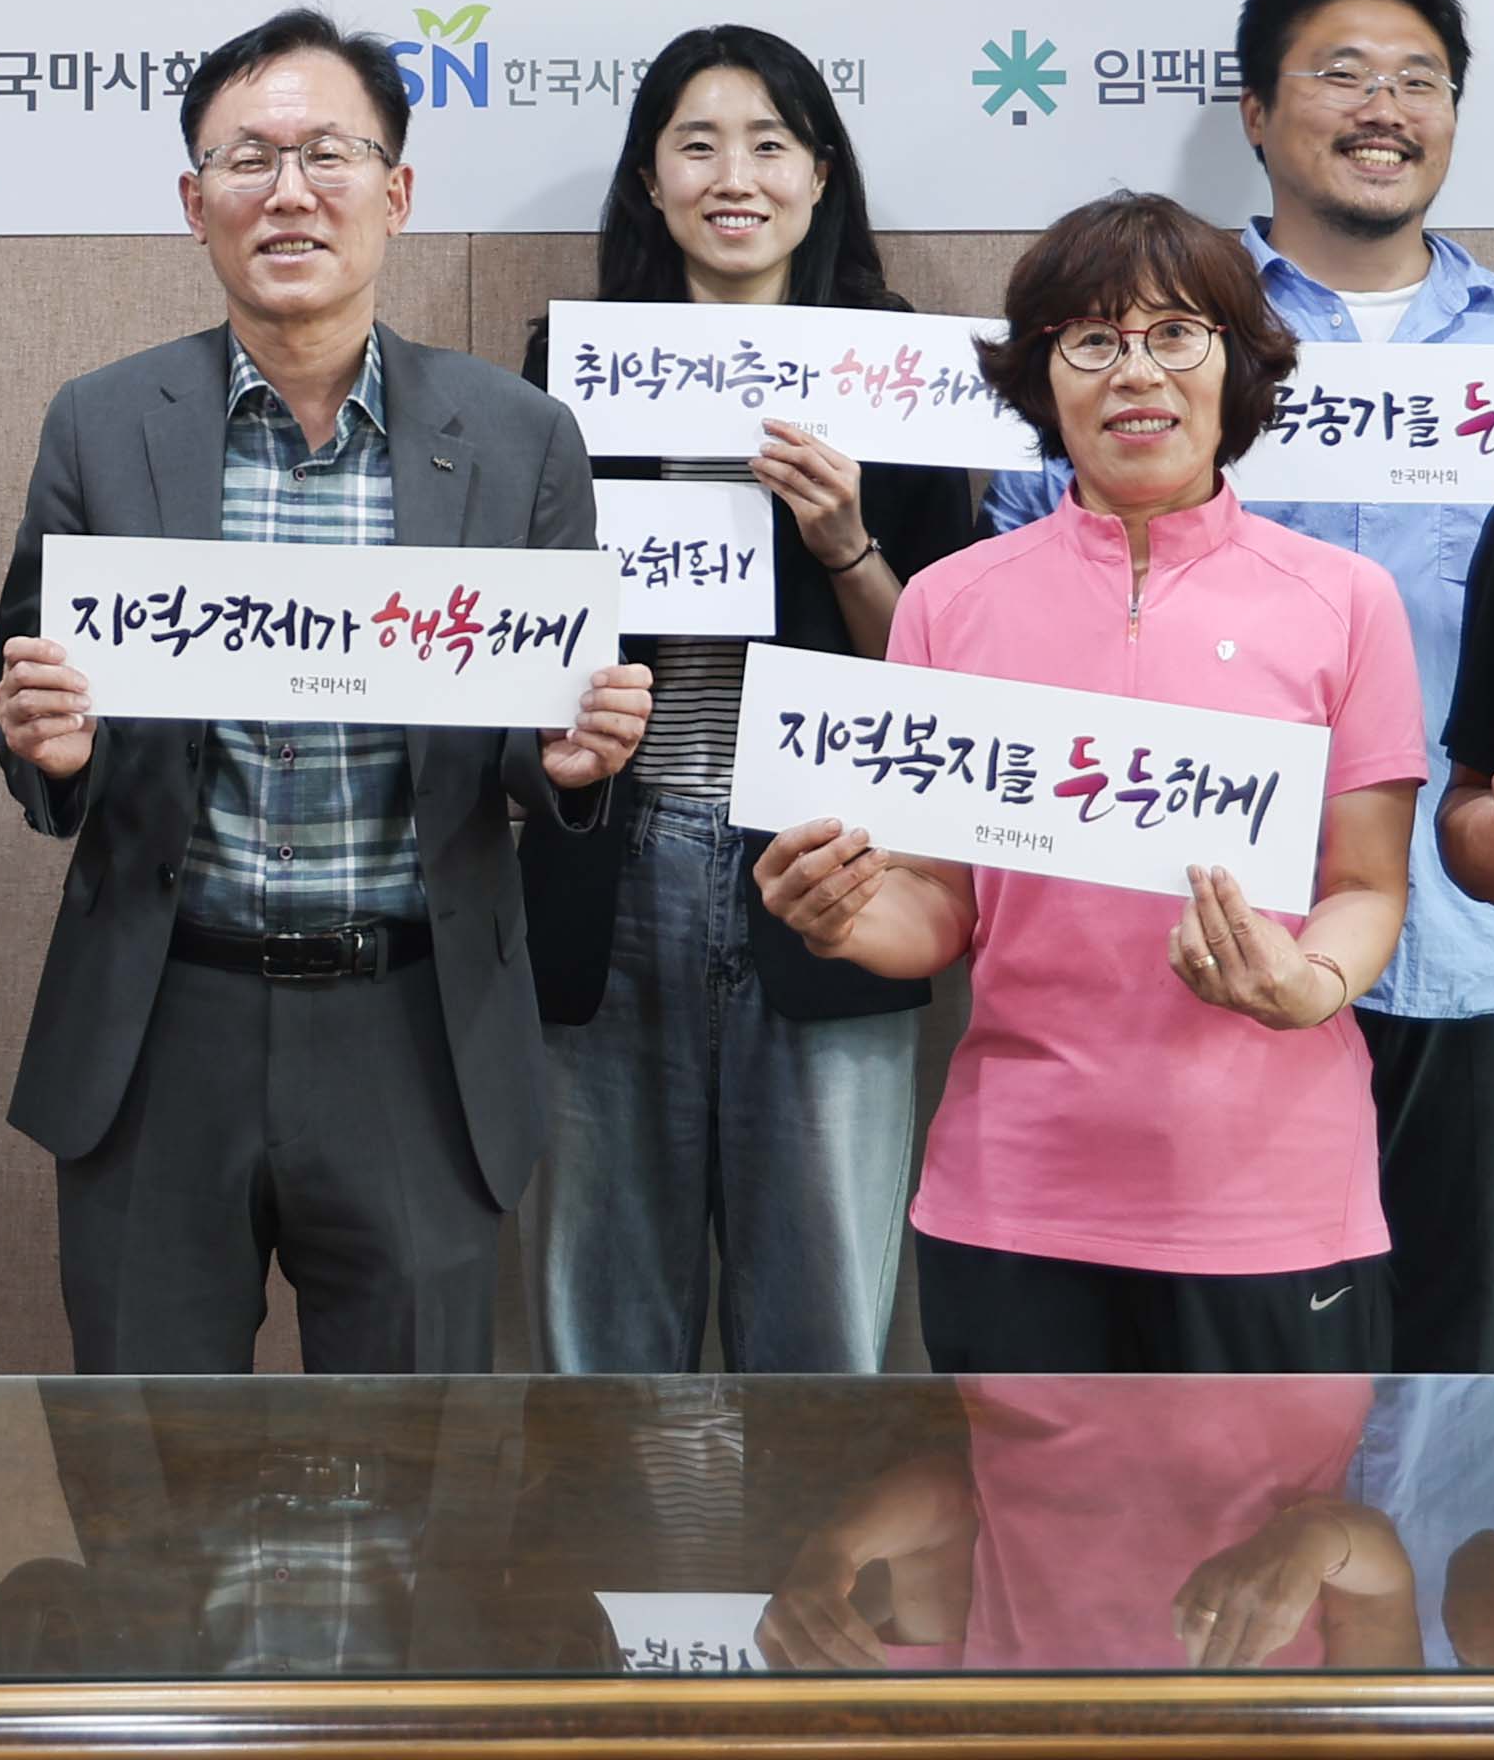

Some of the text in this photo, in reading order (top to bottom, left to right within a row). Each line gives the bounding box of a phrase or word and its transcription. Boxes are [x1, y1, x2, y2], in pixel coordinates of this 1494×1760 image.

[574, 340, 820, 409] 취약계층과
[1391, 470, 1457, 483] 한국마사회
[71, 584, 589, 675] 지역경제가 행복하게
[291, 677, 366, 694] 한국마사회
[779, 711, 1279, 846] 지역복지를 든든하게
[976, 826, 1053, 852] 한국마사회
